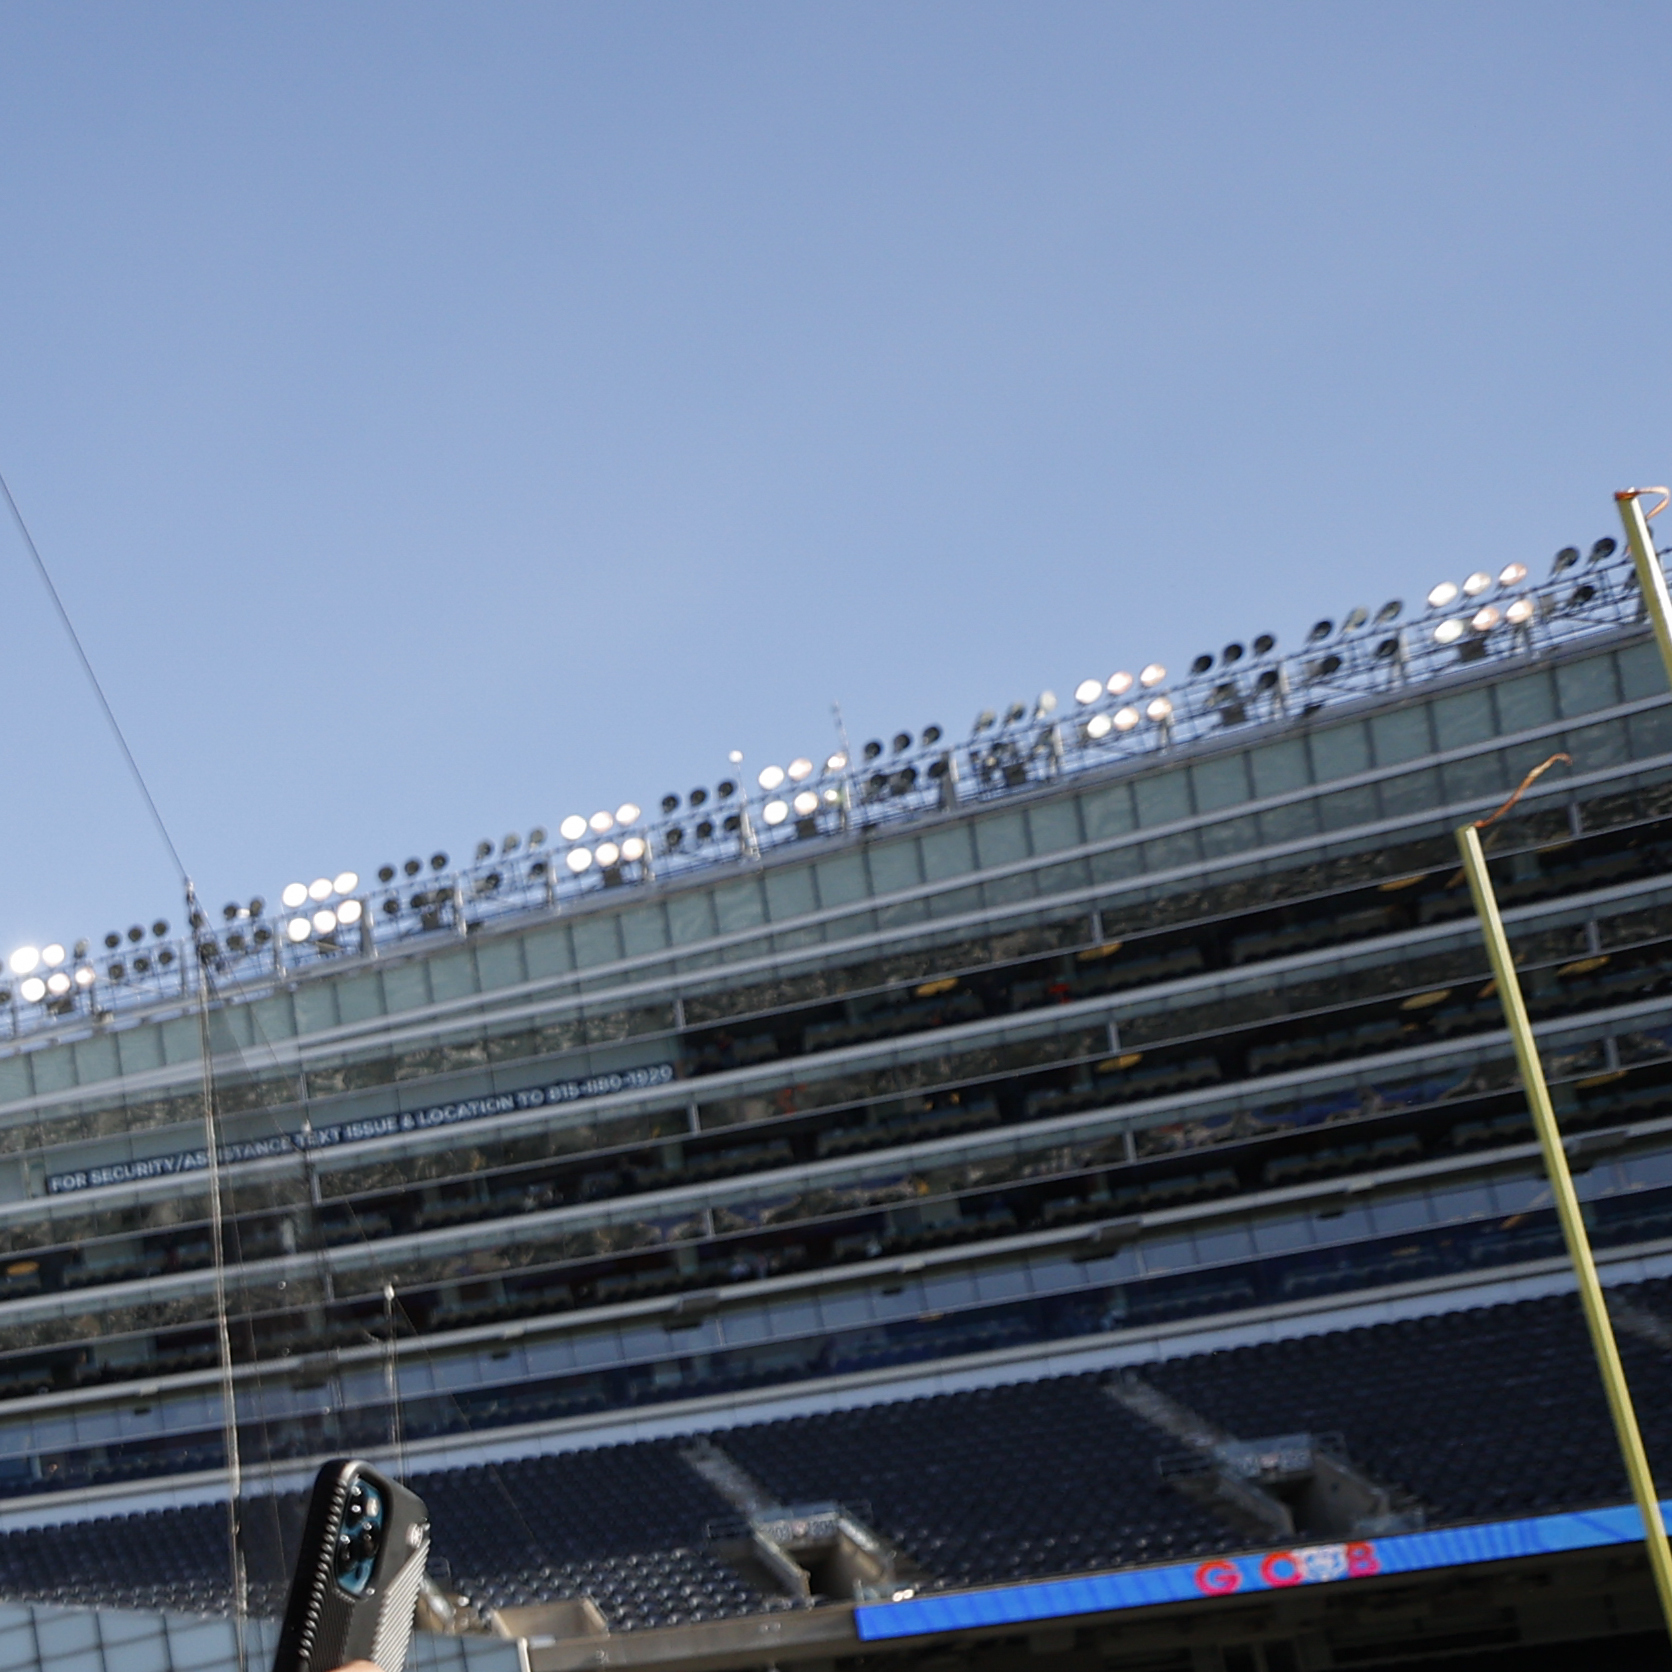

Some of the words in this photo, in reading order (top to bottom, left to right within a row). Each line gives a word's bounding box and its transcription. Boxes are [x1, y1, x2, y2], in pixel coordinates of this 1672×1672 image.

[51, 1172, 88, 1192] FOR
[296, 1127, 342, 1148] TEXT
[346, 1115, 398, 1138] ISSUE
[400, 1112, 415, 1130] &
[418, 1094, 515, 1125] LOCATION
[517, 1088, 545, 1109] TO
